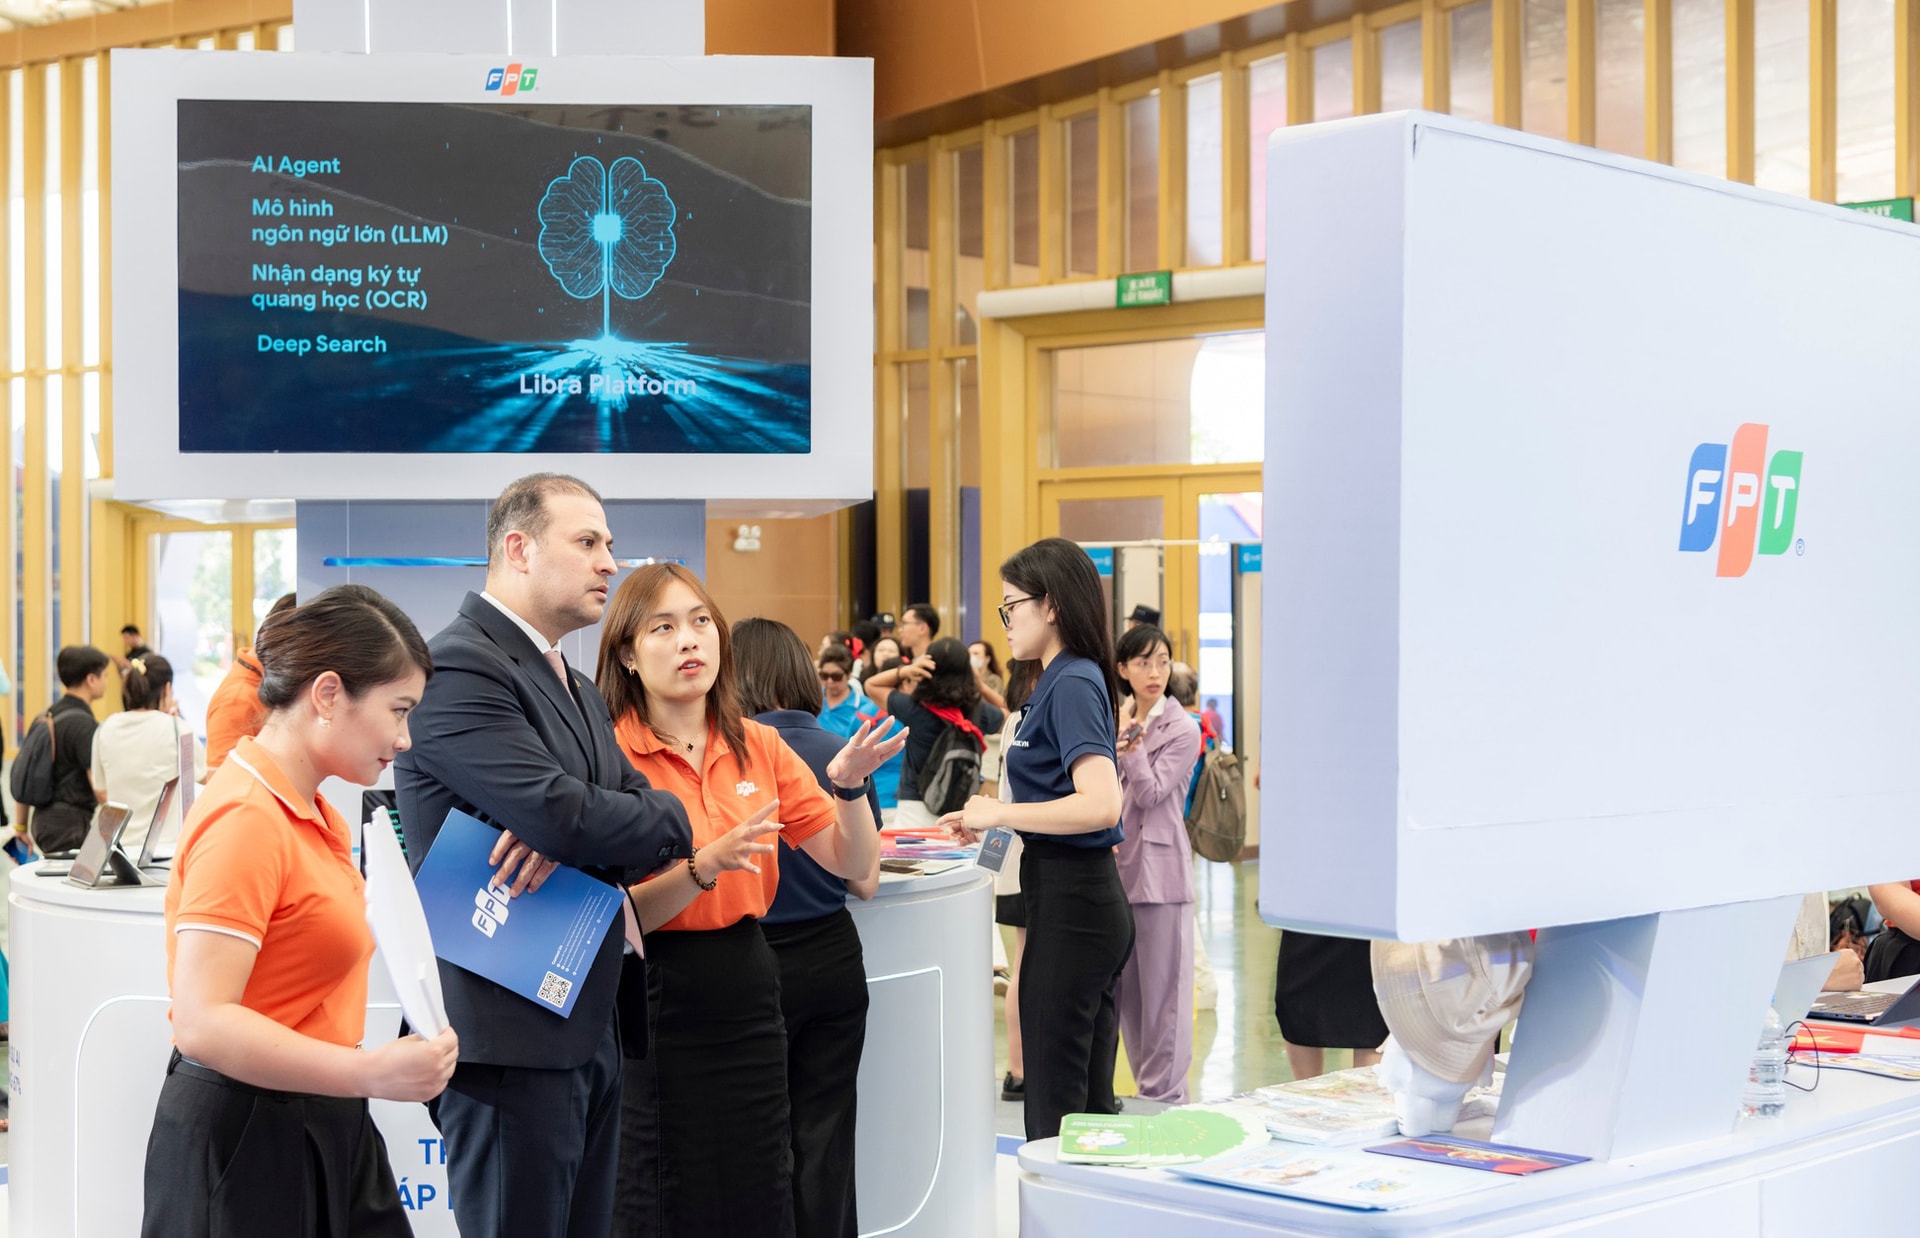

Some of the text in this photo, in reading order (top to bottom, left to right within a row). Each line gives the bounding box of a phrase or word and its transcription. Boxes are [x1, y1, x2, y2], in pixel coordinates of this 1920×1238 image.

[251, 155, 341, 177] AI Agent
[252, 198, 284, 216] Mô
[251, 224, 449, 247] ngôn ngữ lớn (LLM)
[252, 263, 422, 287] Nhận dạng ký tự
[251, 289, 427, 312] quang học (OCR)
[257, 334, 387, 357] Deep Search
[519, 373, 697, 395] Libra Platform
